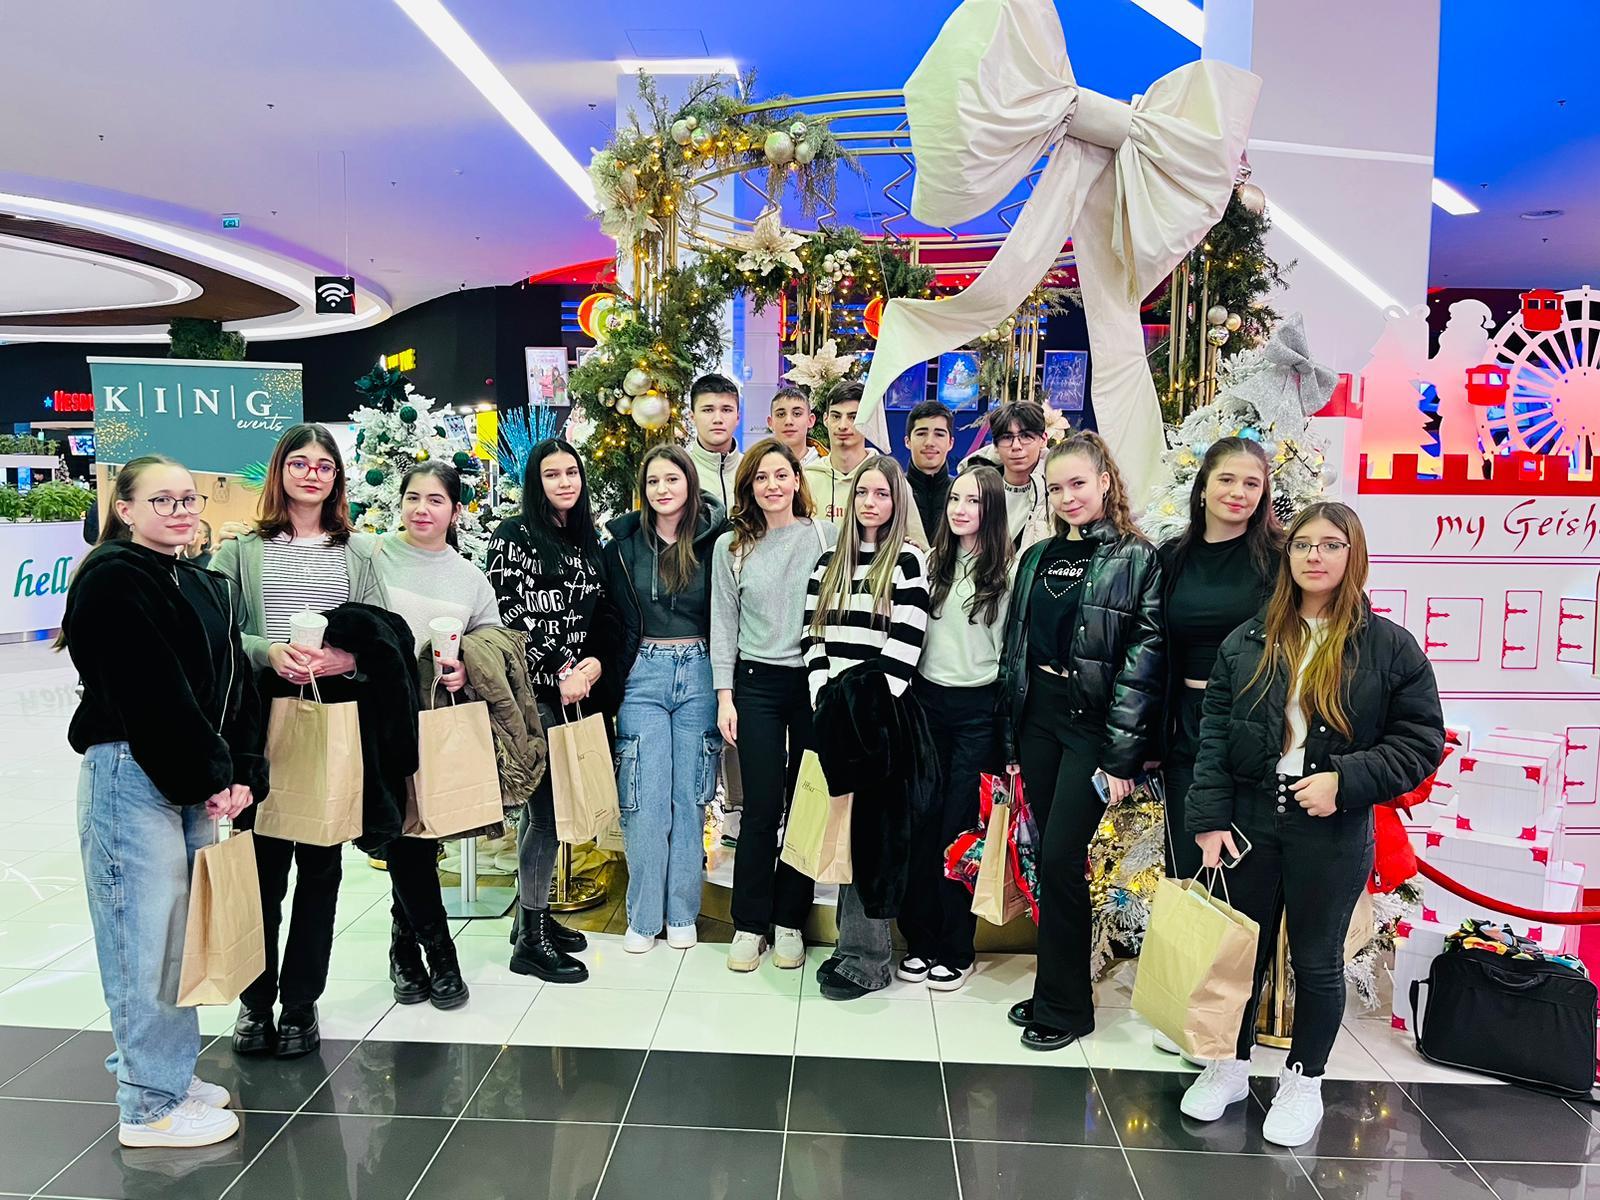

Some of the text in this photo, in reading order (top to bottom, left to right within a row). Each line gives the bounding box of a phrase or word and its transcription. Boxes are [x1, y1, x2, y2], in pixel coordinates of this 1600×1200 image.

[236, 413, 293, 432] events
[1430, 498, 1600, 553] my Geish
[13, 556, 73, 598] hell
